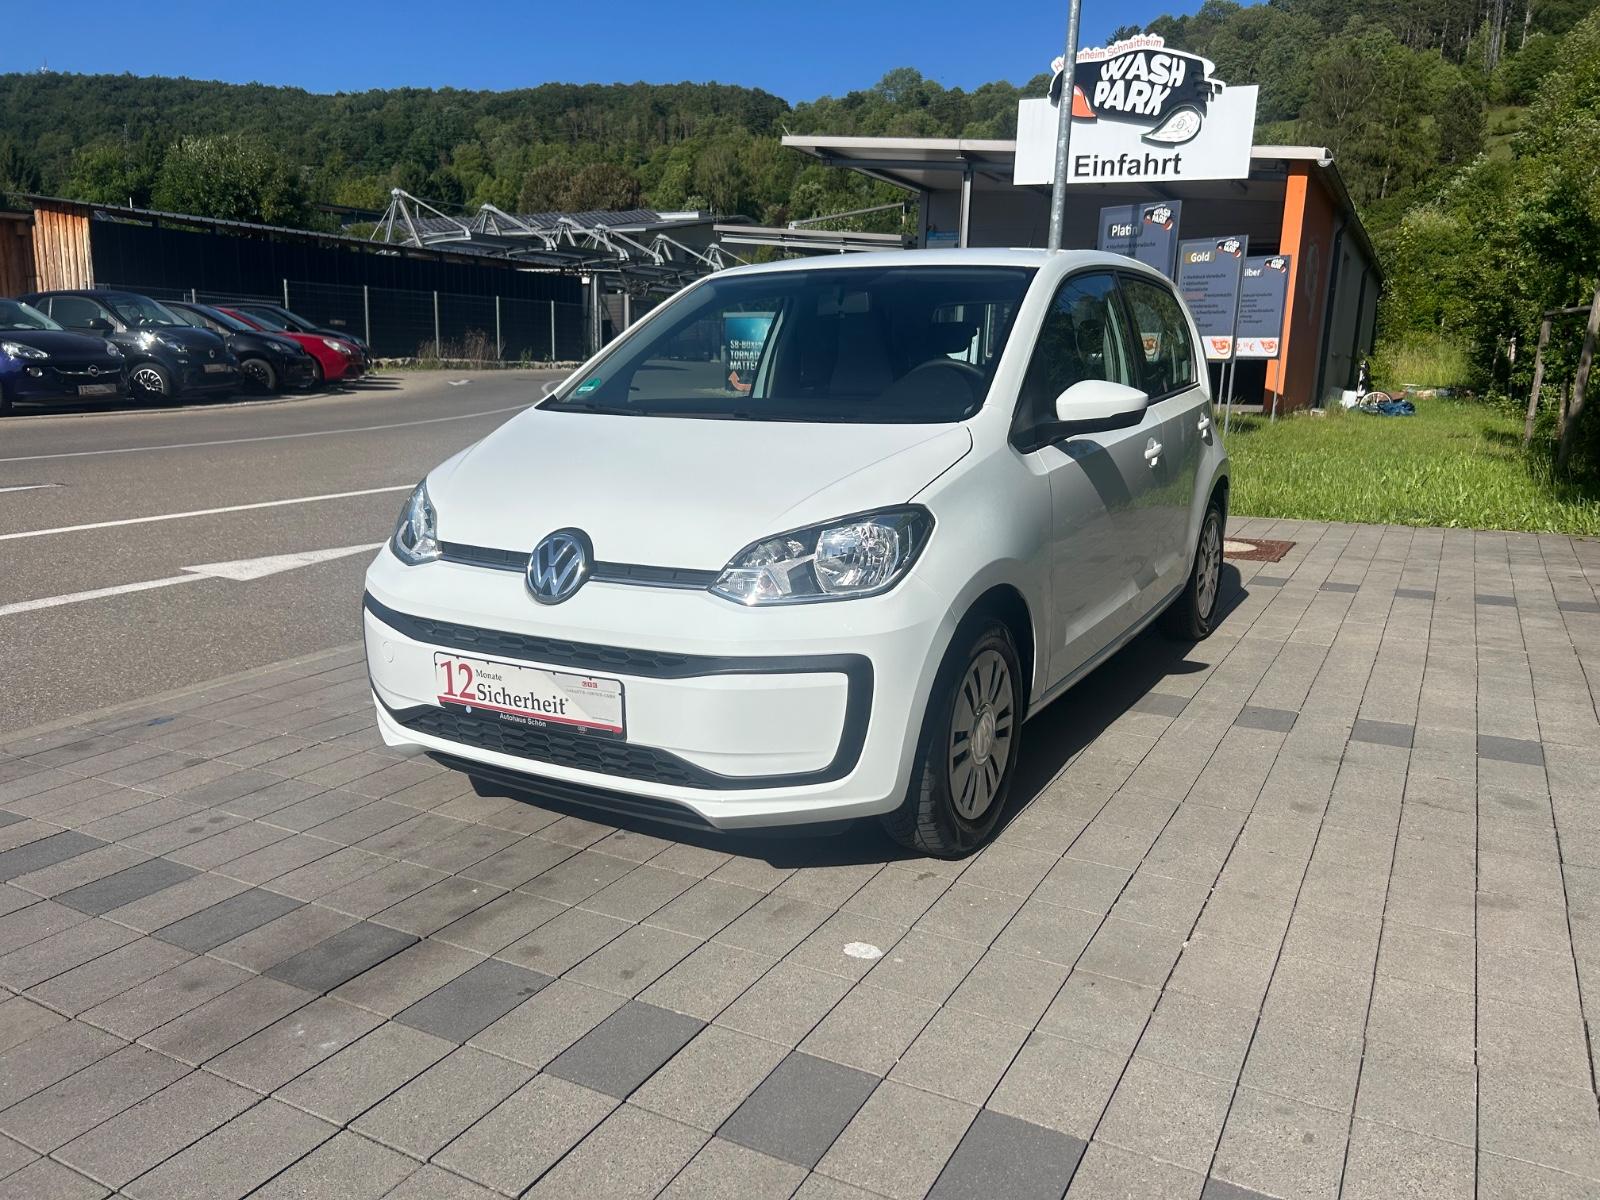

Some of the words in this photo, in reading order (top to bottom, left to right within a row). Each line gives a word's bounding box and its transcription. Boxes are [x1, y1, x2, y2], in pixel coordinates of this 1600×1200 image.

[1054, 48, 1105, 71] Henheim
[1108, 37, 1162, 57] Schnaitheim
[1100, 52, 1186, 87] WASH
[1093, 79, 1171, 116] PARK
[1074, 153, 1182, 177] Einfahrt
[1111, 223, 1138, 237] Platin
[1190, 252, 1210, 263] Gold
[1244, 268, 1261, 277] ilber
[730, 350, 760, 360] TORNAD
[527, 533, 584, 602] VW
[440, 660, 476, 700] 12
[475, 669, 503, 681] Monate
[499, 713, 526, 724] Autohaus
